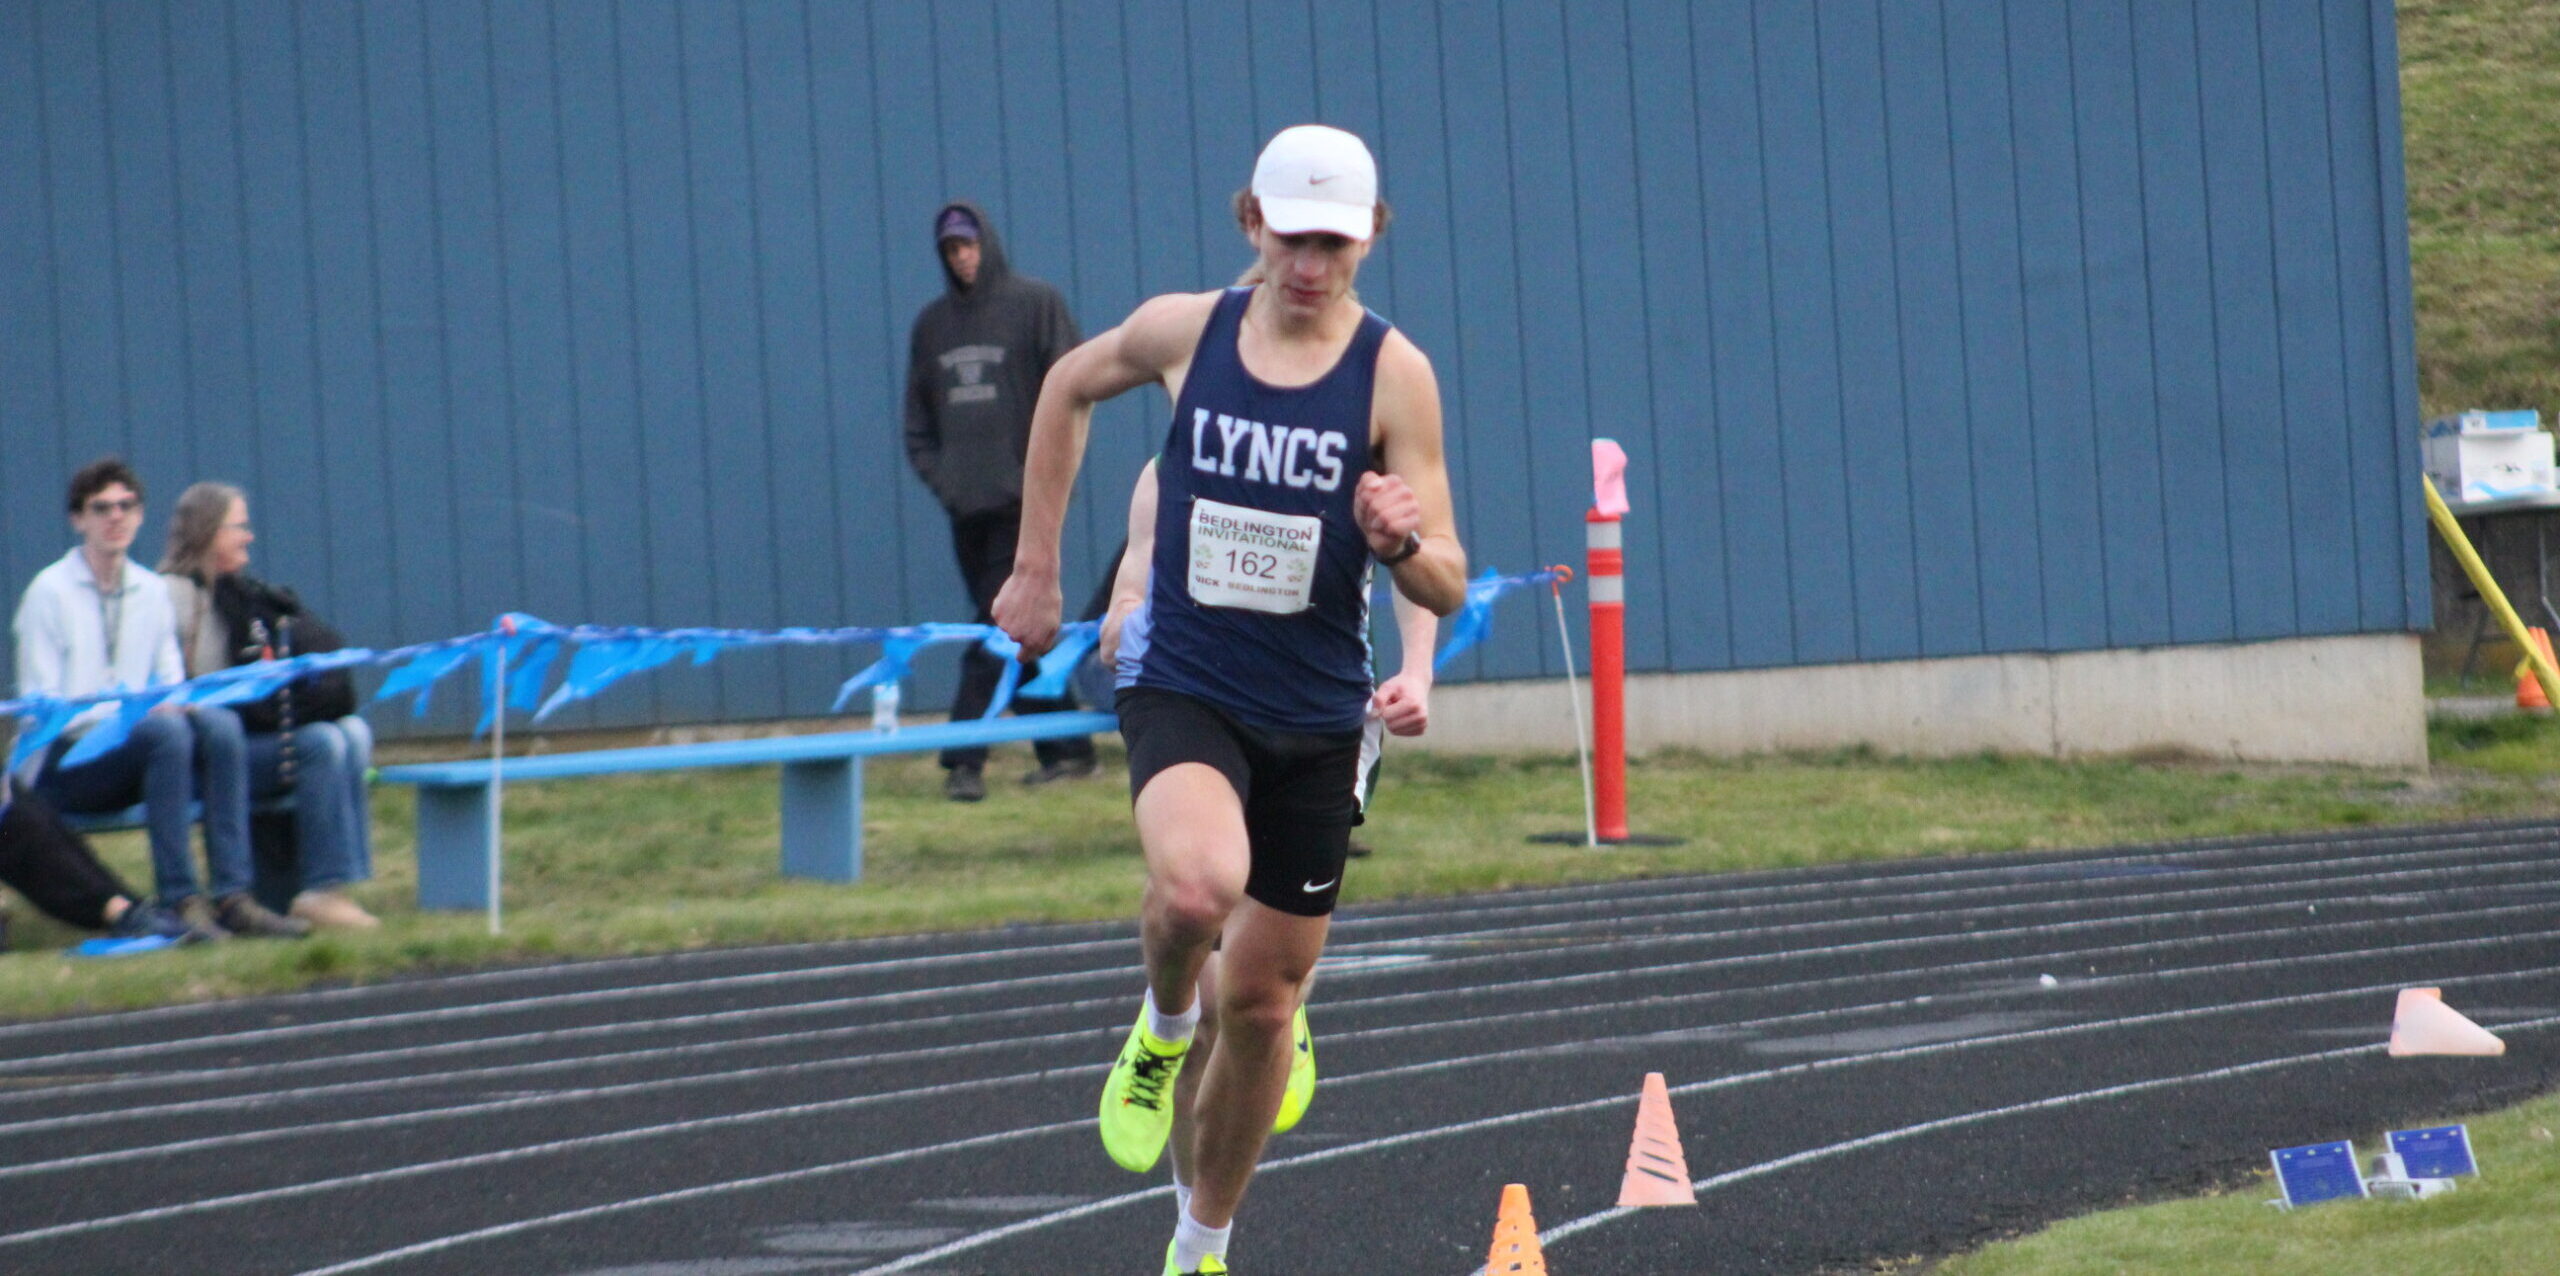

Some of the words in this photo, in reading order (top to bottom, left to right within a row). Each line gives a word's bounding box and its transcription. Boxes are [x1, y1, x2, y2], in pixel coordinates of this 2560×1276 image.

[1192, 407, 1348, 492] LYNCS
[1198, 526, 1309, 552] INVITATIONAL
[1199, 512, 1313, 541] BEDLINGTON
[1226, 549, 1277, 580] 162
